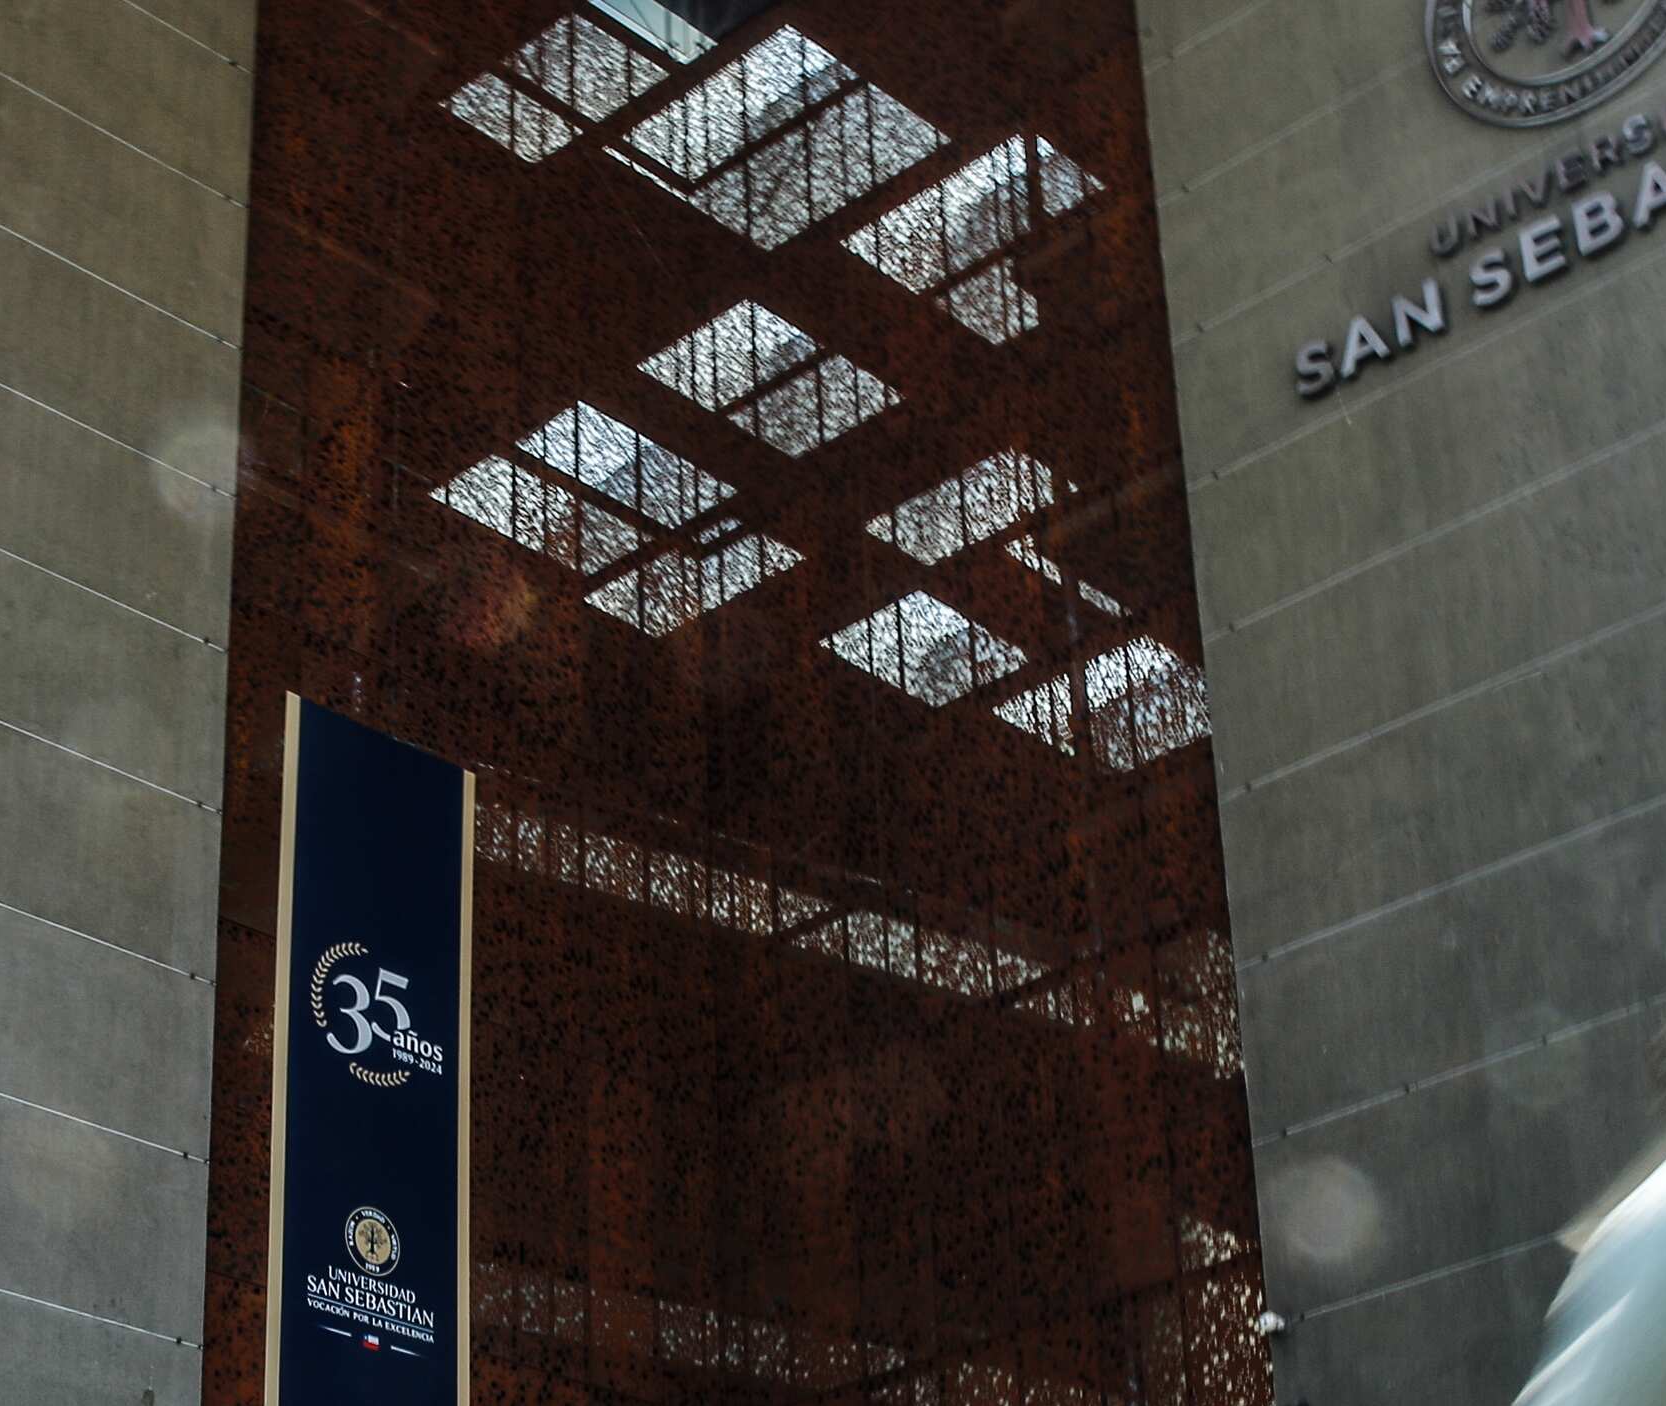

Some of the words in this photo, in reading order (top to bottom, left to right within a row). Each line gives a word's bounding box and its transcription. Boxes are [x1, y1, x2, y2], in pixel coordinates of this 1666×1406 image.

[1293, 277, 1448, 399] SAN
[326, 967, 411, 1055] 35
[393, 1029, 443, 1063] años
[307, 1274, 340, 1300] SAN
[344, 1286, 434, 1329] SEBASTIAN
[328, 1264, 416, 1304] UNIVERSIDAD
[307, 1297, 350, 1319] VOCACIÓN
[353, 1312, 370, 1325] POR
[372, 1318, 383, 1329] LA
[384, 1321, 435, 1343] EXCELENCIA
